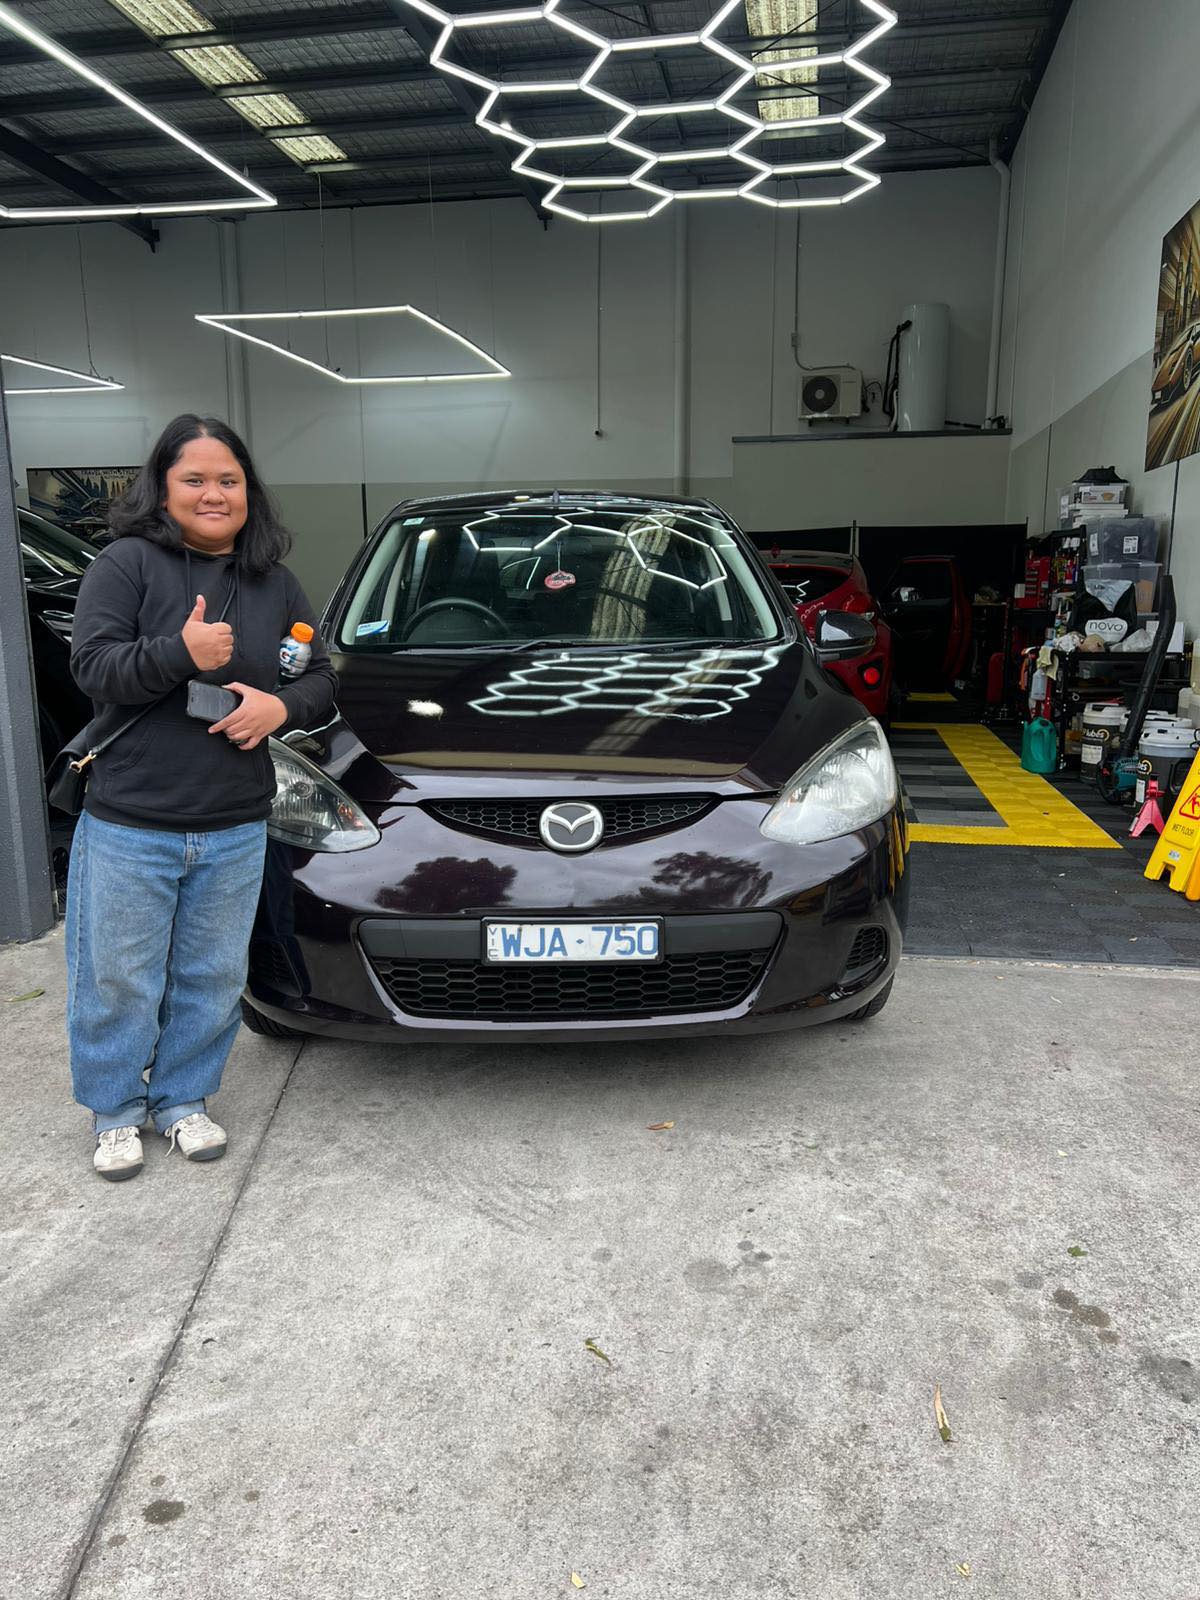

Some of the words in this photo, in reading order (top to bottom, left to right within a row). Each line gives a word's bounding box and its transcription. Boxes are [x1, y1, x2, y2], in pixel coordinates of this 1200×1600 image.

[1089, 621, 1123, 632] novo
[1172, 823, 1182, 832] WET
[1181, 825, 1195, 837] FLOOR
